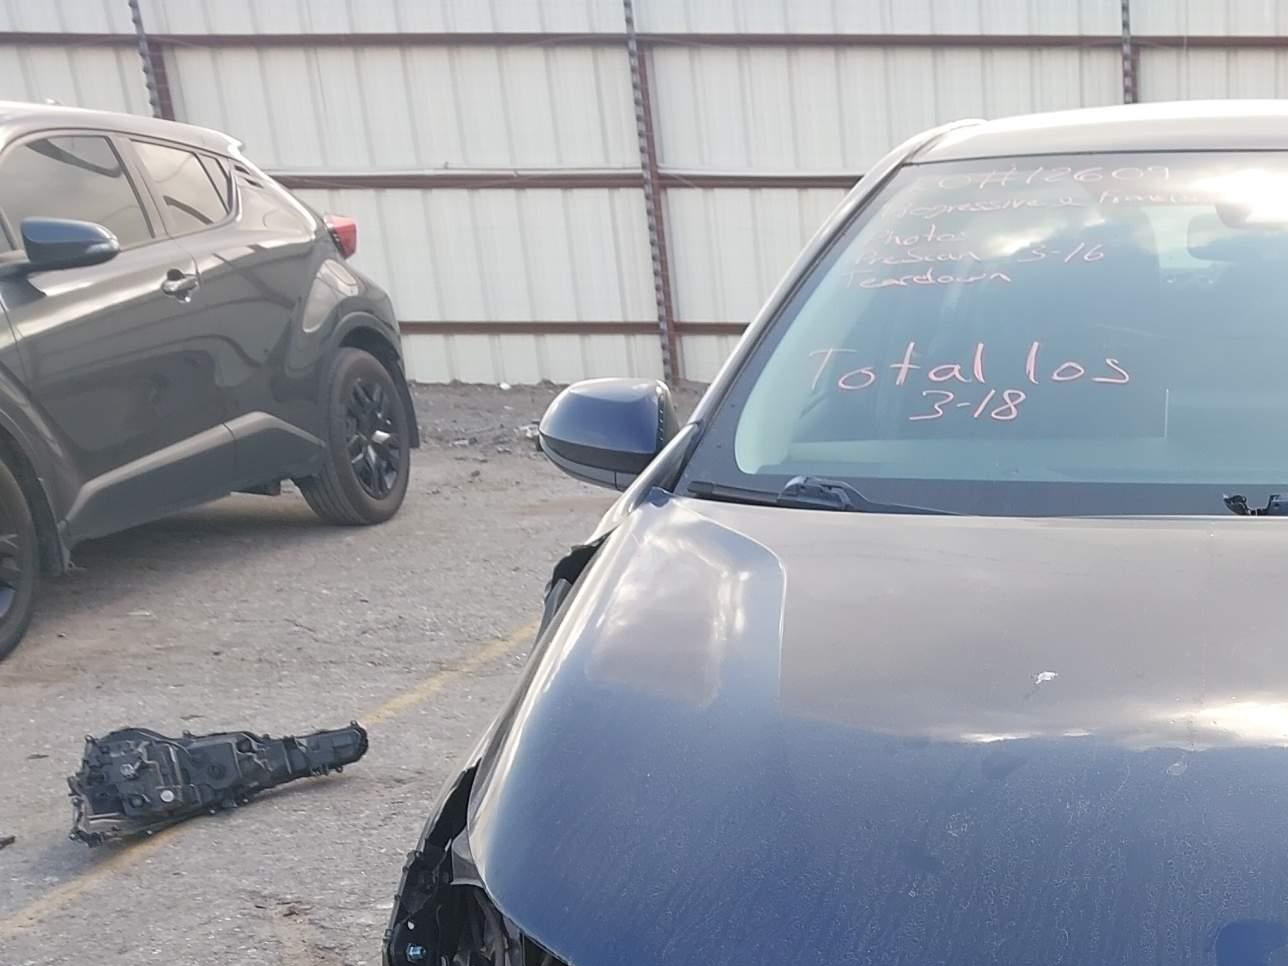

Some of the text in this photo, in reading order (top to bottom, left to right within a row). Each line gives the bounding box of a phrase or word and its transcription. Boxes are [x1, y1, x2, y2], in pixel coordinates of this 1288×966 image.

[809, 341, 1130, 390] Total los
[909, 389, 1027, 421] 3-18
